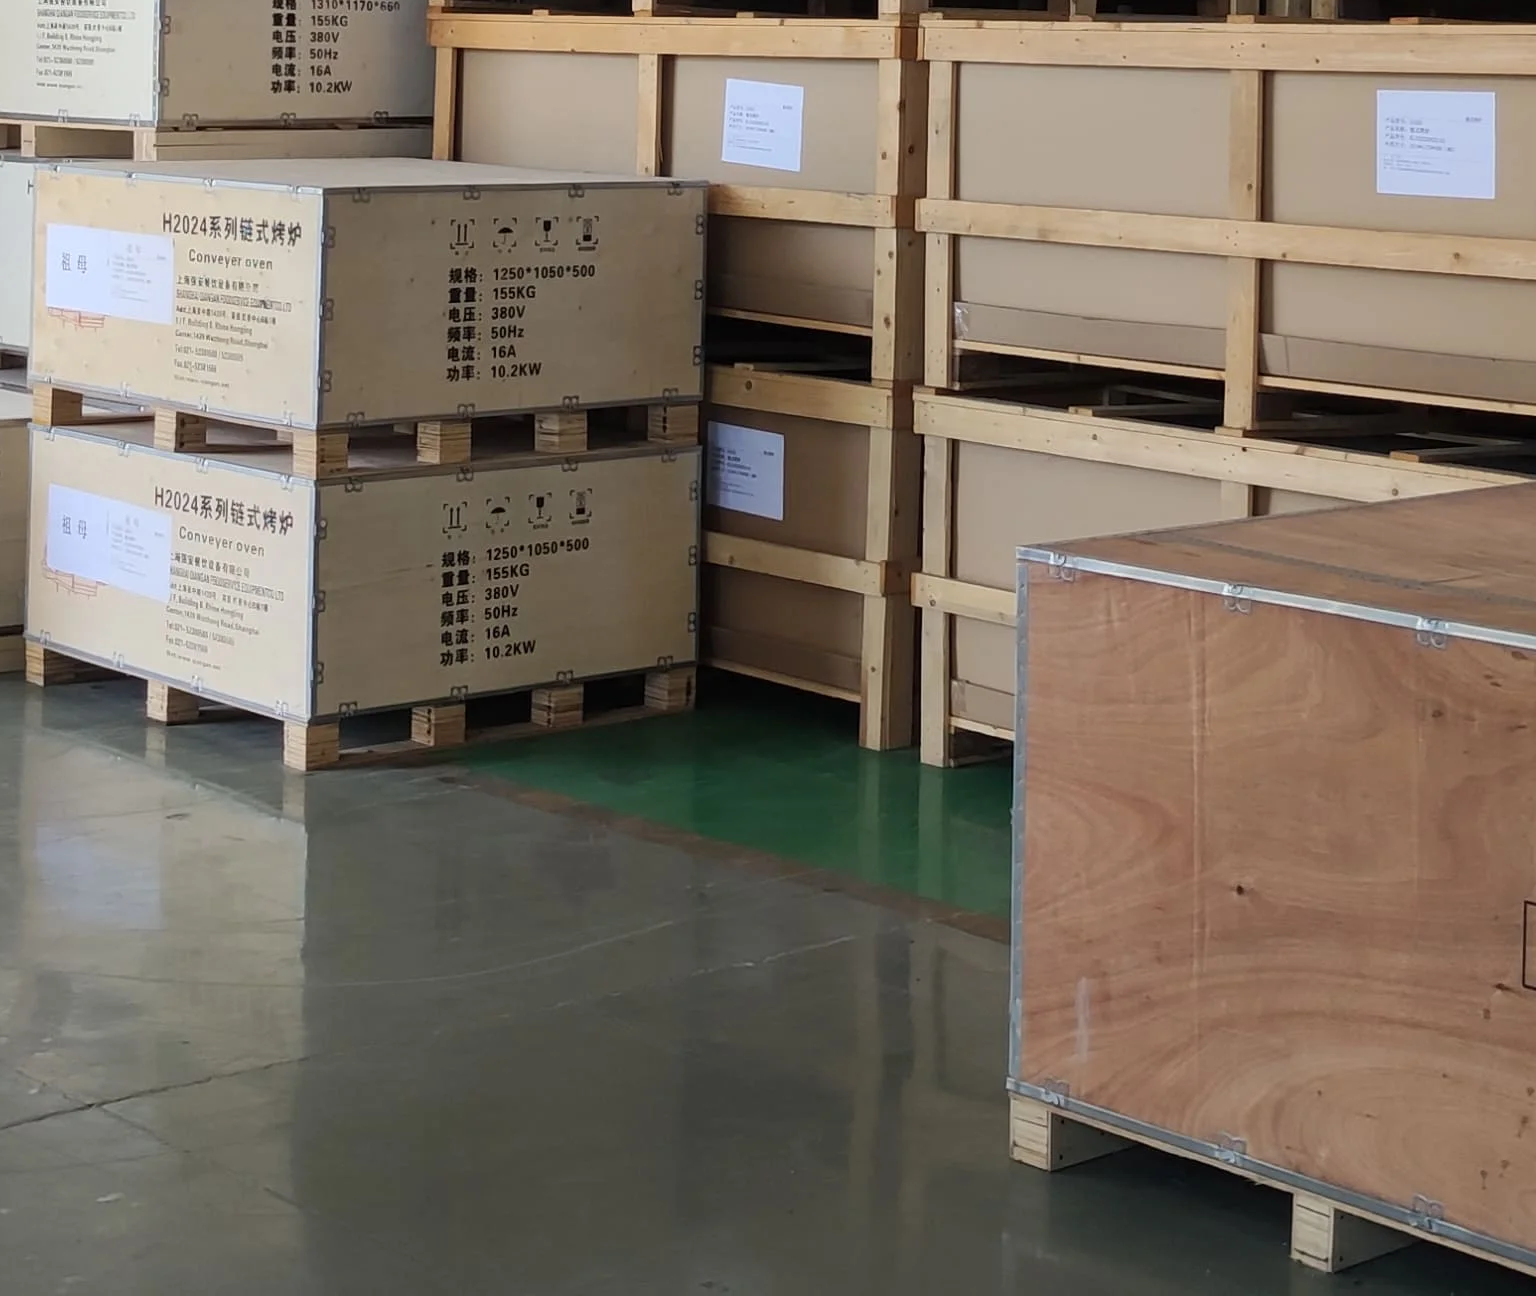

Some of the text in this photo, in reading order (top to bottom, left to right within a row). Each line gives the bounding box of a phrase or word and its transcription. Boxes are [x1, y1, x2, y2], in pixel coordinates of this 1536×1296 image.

[311, 15, 348, 27] 155KG
[310, 31, 339, 43] 380V
[310, 48, 338, 60] 50Hz
[310, 65, 331, 77] 16A
[309, 80, 352, 93] 10.2KW
[162, 212, 303, 247] H2024系列链式烤炉
[189, 249, 273, 270] Conveyer oven
[493, 285, 536, 300] 155KG
[491, 305, 525, 320] 380V
[491, 325, 524, 339] 50Hz
[491, 344, 516, 359] 16A
[491, 362, 541, 378] 10.2KW
[154, 486, 294, 536] H2024系列链式烤炉
[179, 526, 265, 557] Conveyer oven
[486, 563, 529, 581] 155KG
[485, 584, 519, 601] 380V
[484, 604, 518, 620] 50Hz
[485, 624, 510, 640] 16A
[485, 640, 536, 659] 10.2KW
